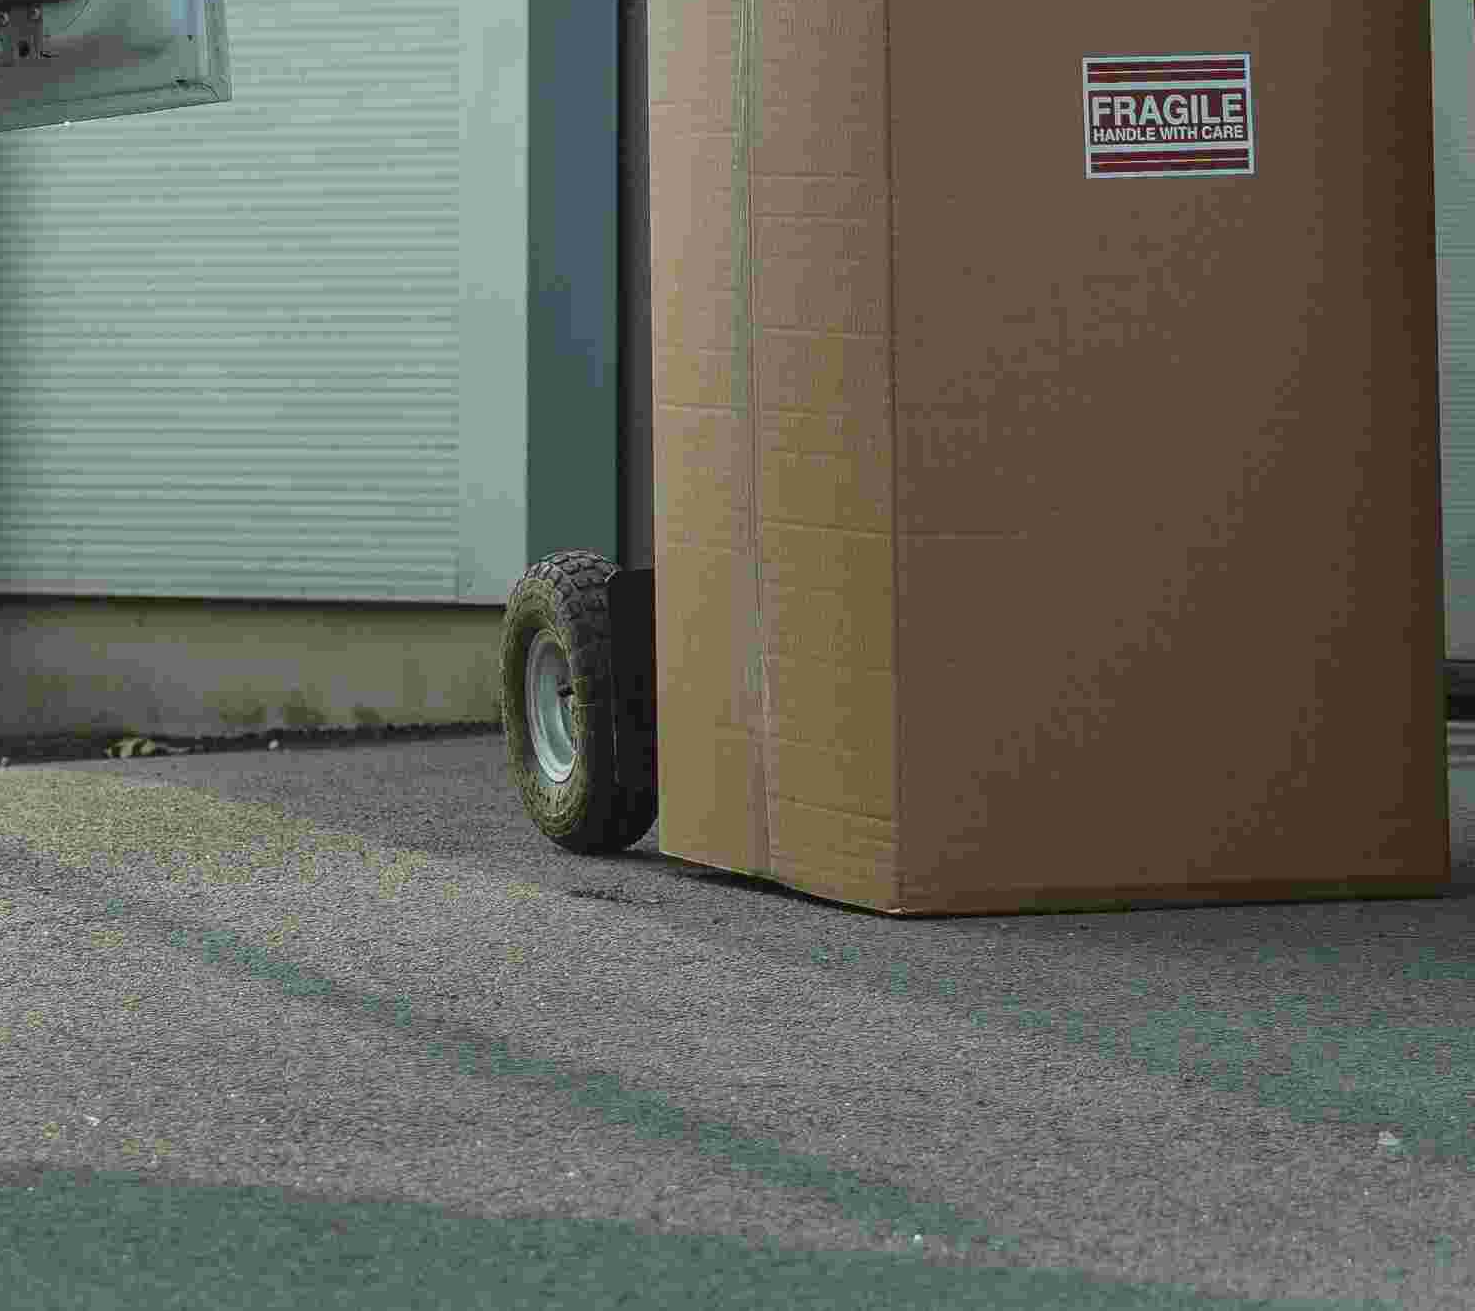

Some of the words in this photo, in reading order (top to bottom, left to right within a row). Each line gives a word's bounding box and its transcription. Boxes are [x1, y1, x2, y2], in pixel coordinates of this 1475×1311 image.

[1091, 93, 1244, 127] FRAGILE
[1093, 126, 1156, 143] HANDLE
[1159, 125, 1197, 141] WITH
[1201, 124, 1244, 140] CARE
